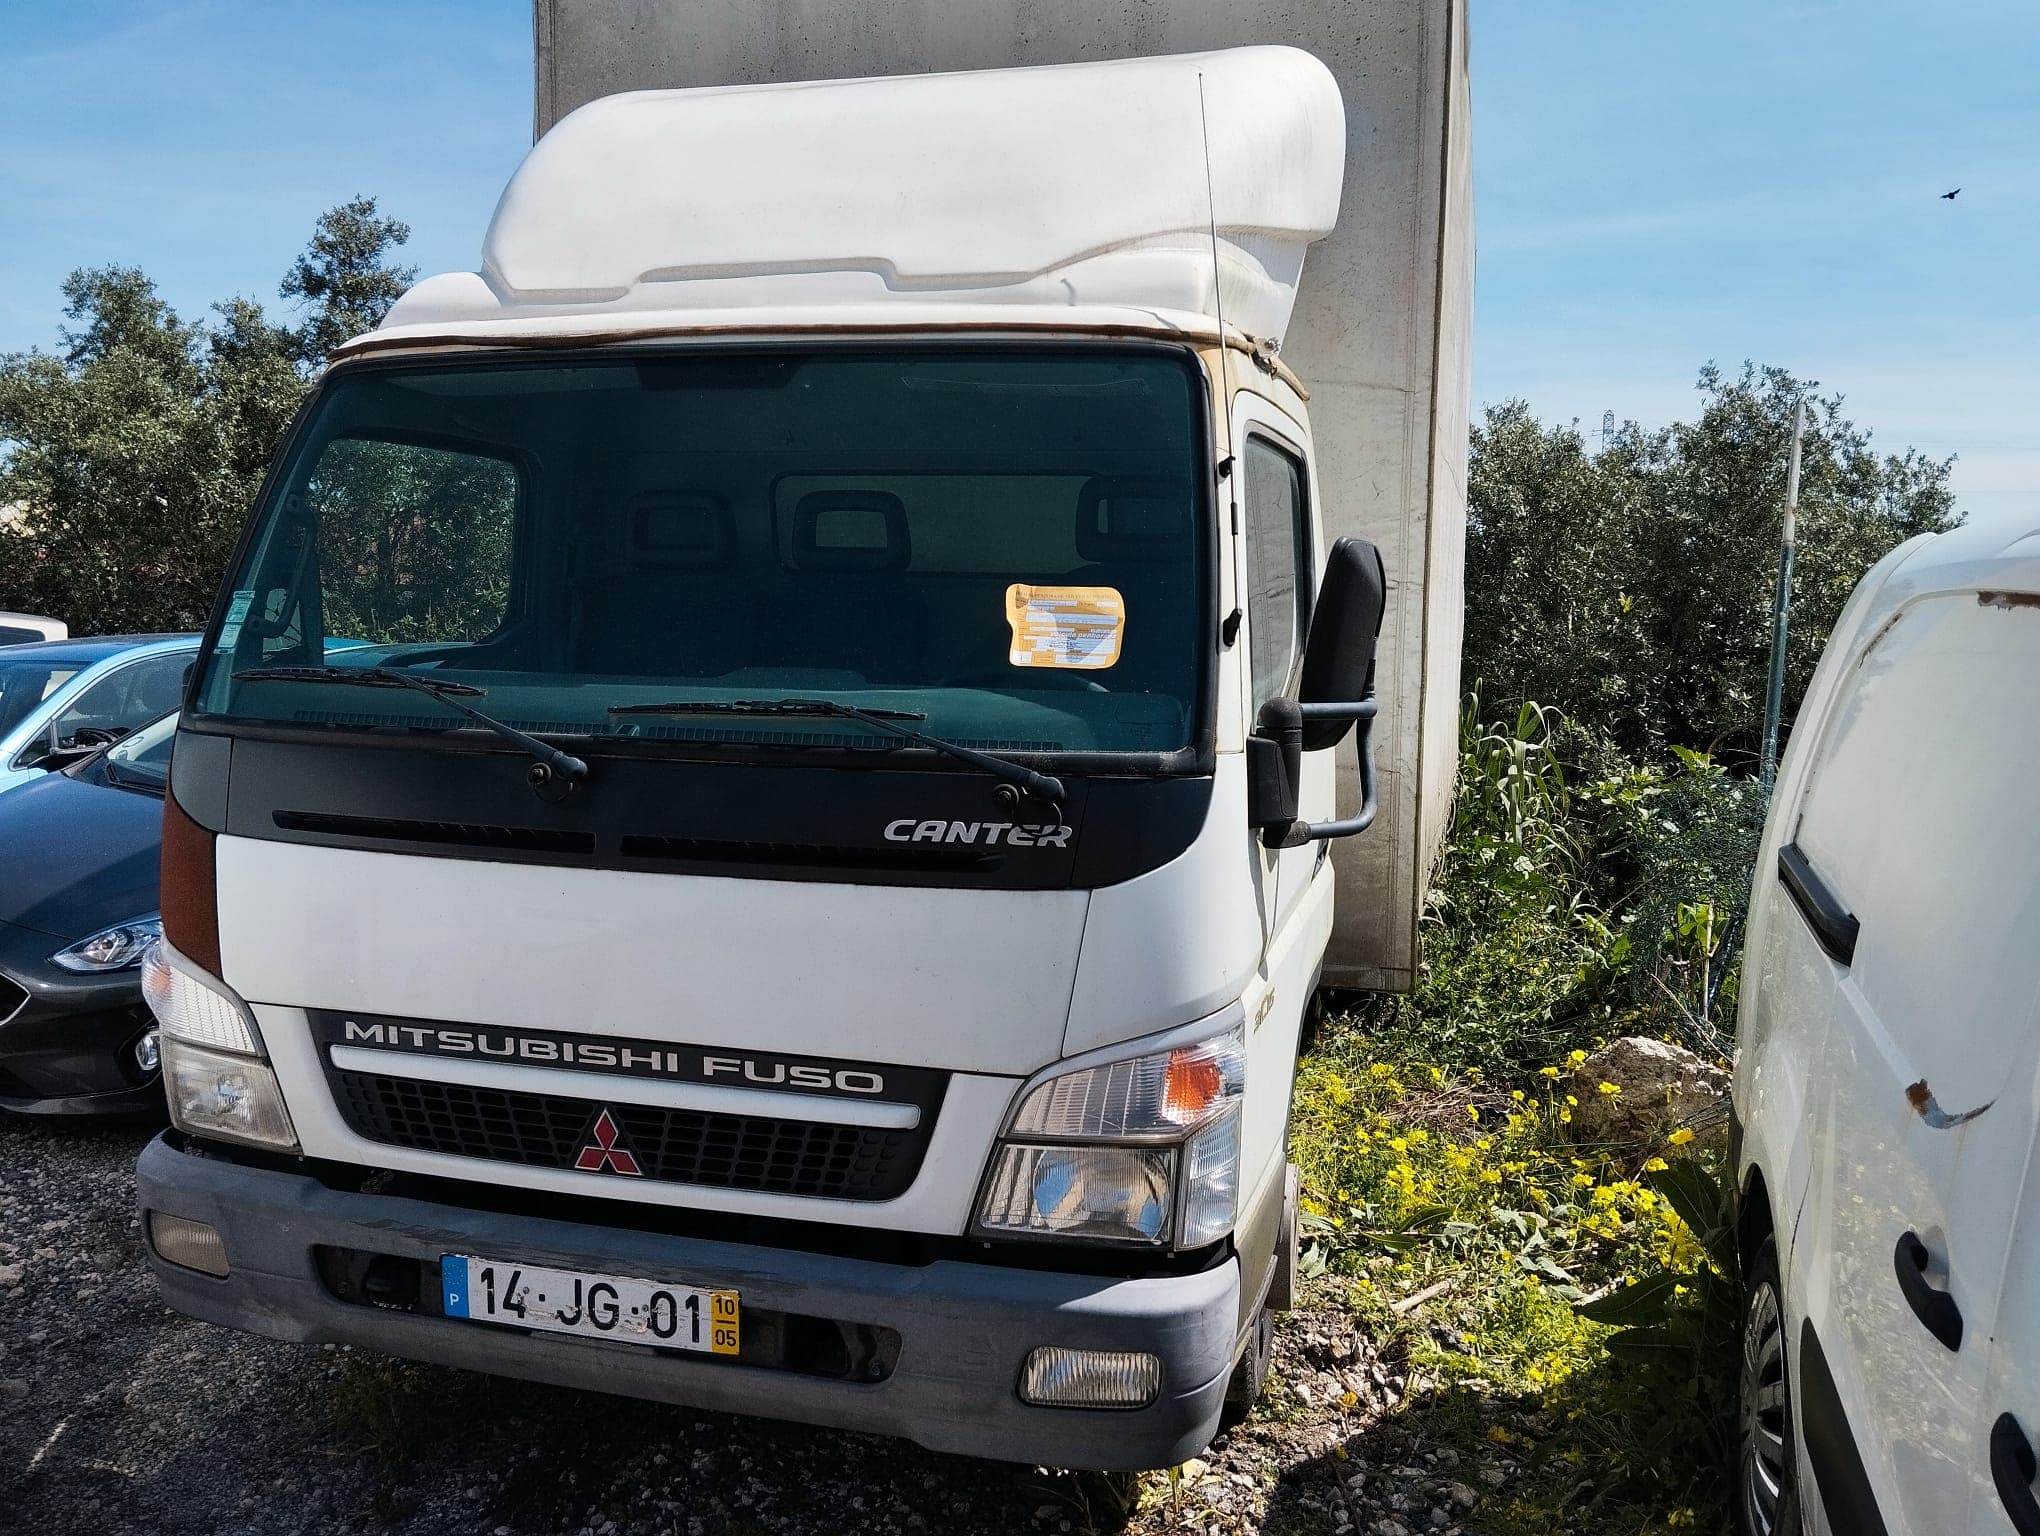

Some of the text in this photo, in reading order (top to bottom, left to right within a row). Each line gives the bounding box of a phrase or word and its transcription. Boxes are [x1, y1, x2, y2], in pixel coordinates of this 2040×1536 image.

[883, 819, 1073, 848] CANTER
[345, 1020, 884, 1094] MITSUBISHI FUSO
[450, 1293, 460, 1306] P
[715, 1297, 735, 1316] 10
[715, 1329, 737, 1347] 05
